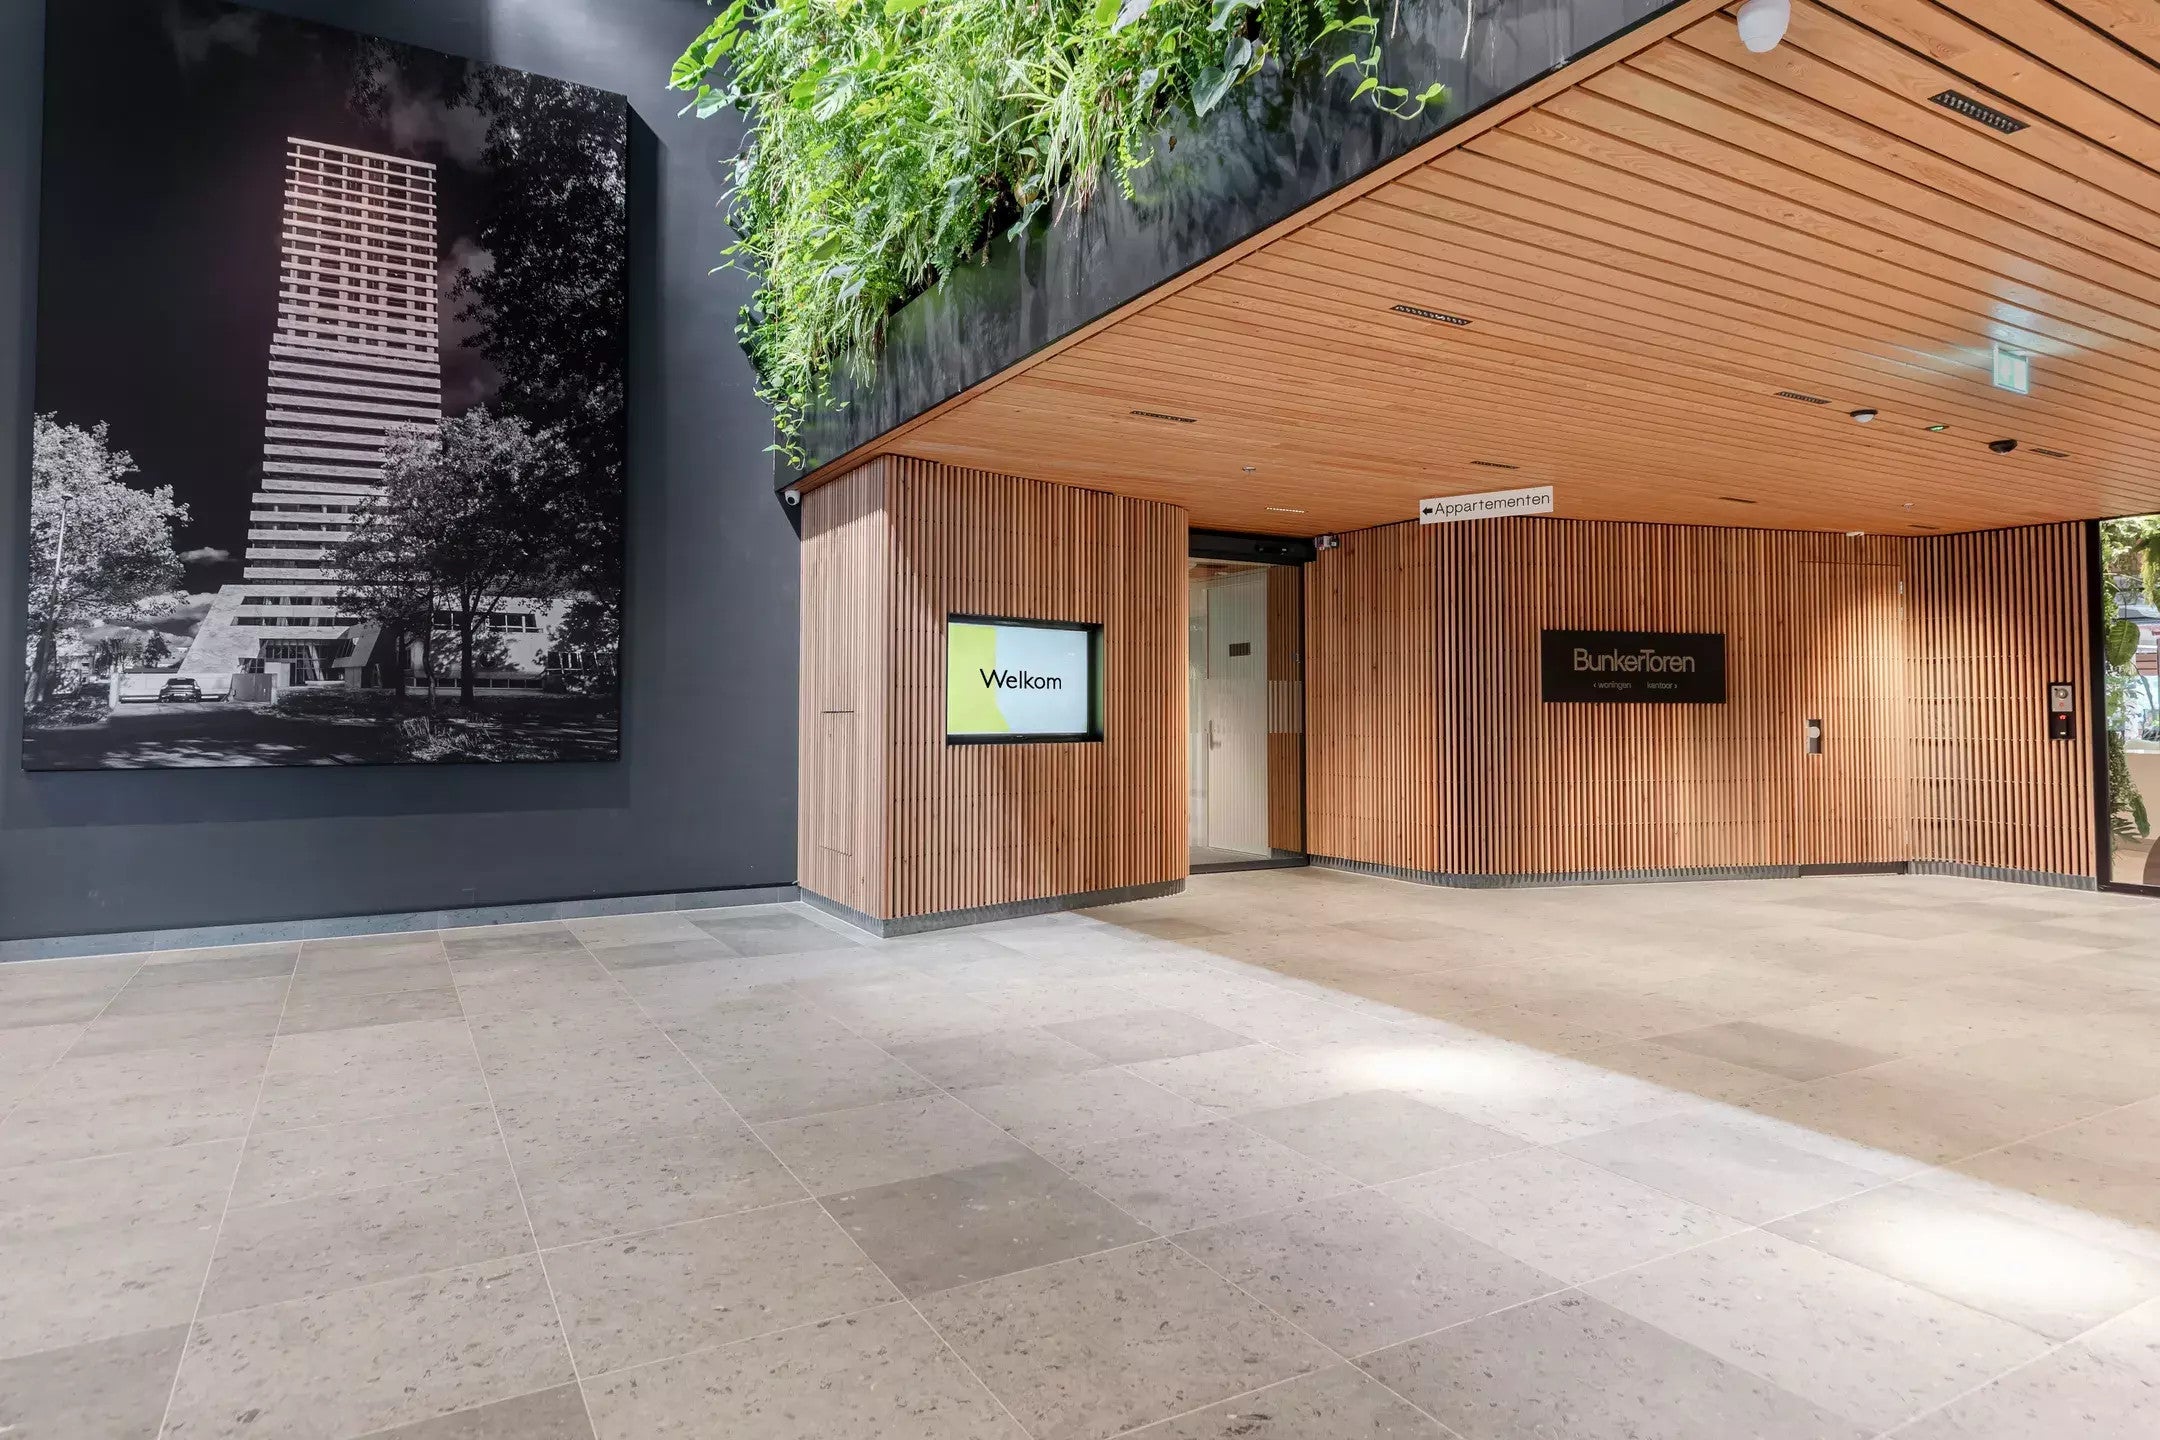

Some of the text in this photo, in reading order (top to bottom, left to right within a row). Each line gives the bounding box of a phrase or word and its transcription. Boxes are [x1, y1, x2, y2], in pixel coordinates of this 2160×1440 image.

[1434, 494, 1550, 517] Appartementen
[1573, 648, 1696, 673] BunkerToren
[980, 668, 1062, 690] Welkom
